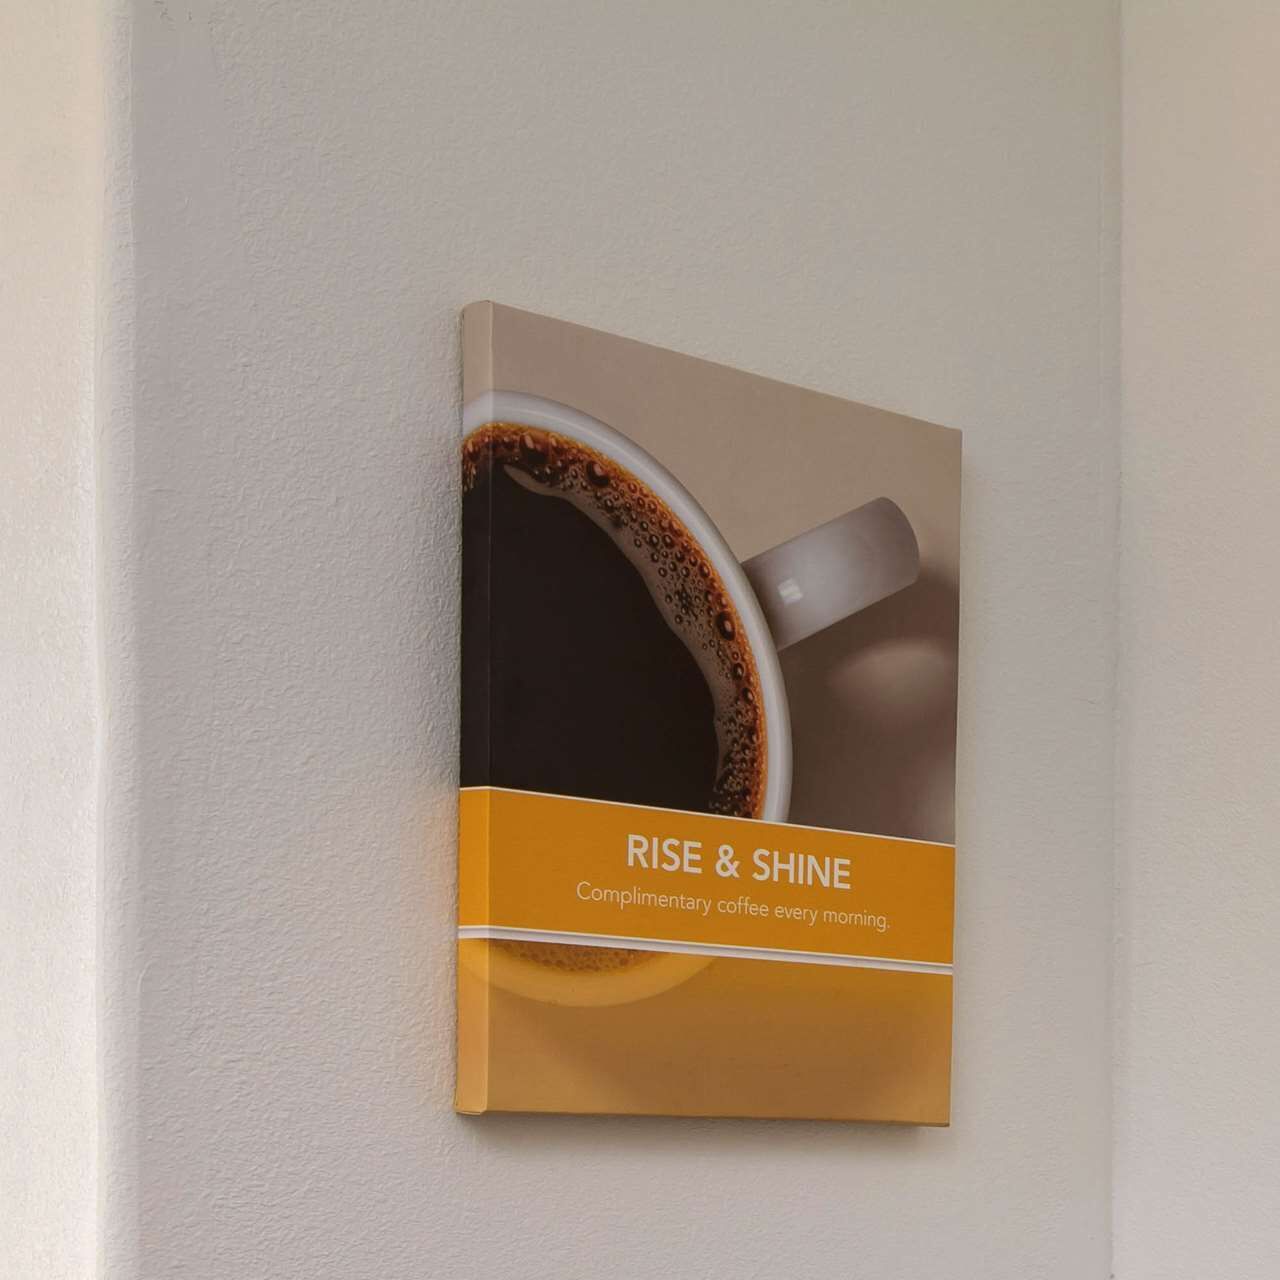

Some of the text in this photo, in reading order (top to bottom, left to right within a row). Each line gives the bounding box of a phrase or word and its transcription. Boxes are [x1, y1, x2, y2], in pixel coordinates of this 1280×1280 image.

[626, 833, 852, 890] RISE & SHINE
[576, 881, 891, 933] Complimentary coffee every morning.
